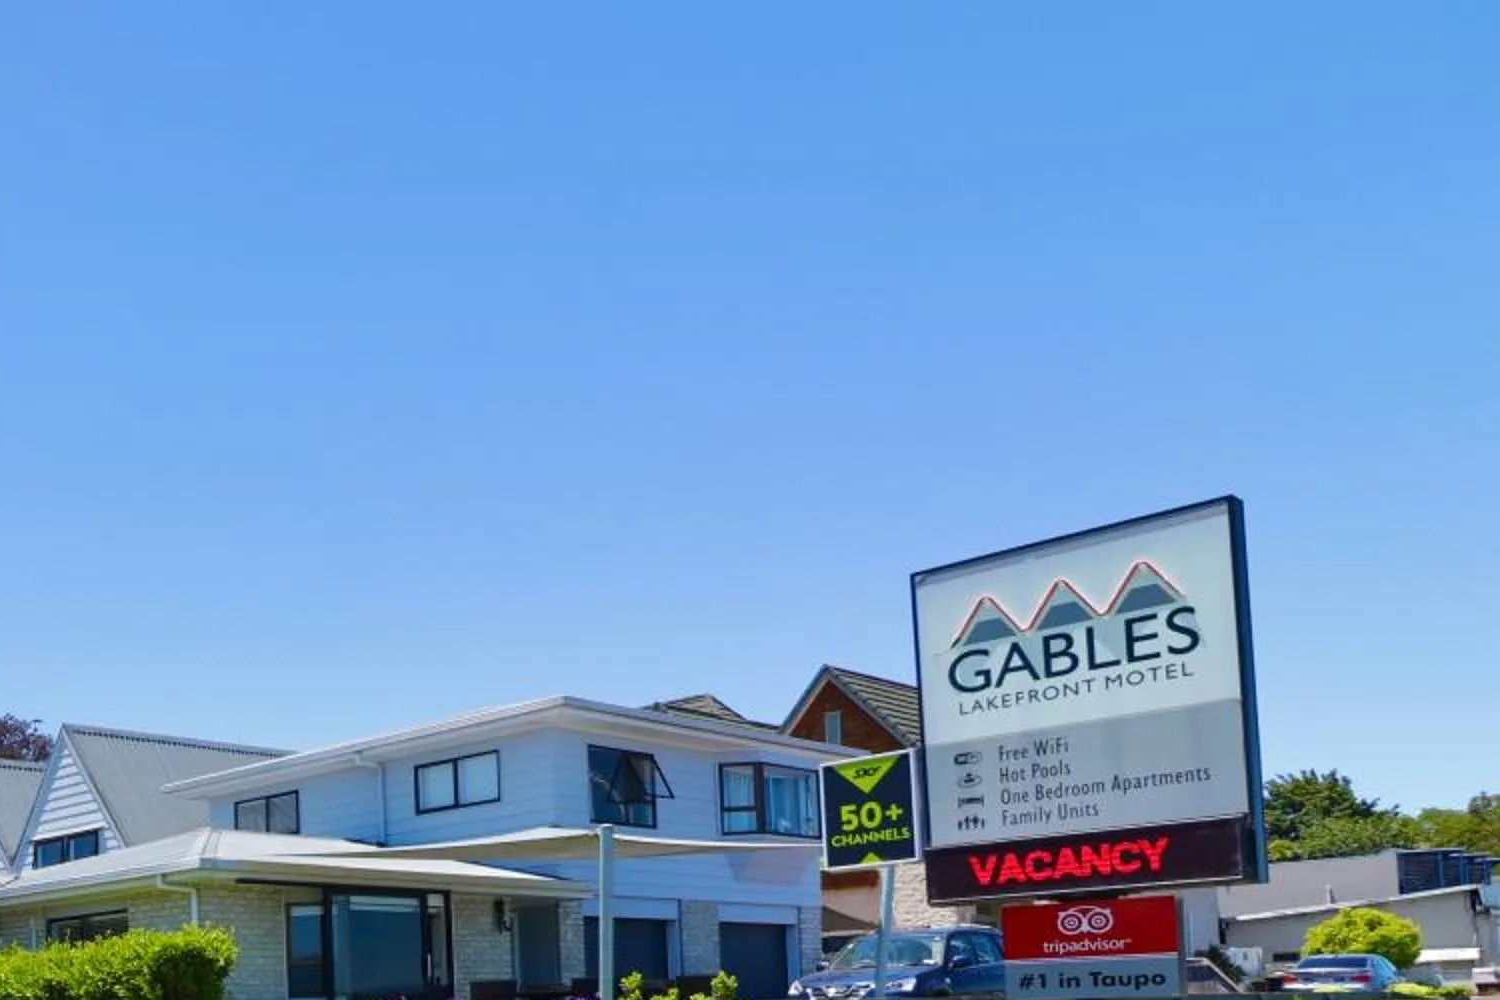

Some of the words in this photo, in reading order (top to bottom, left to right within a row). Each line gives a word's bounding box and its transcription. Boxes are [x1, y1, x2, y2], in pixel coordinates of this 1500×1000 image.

[947, 605, 1201, 694] GABLES
[958, 677, 1097, 716] LAKEFRONT
[1103, 662, 1195, 691] MOTEL
[998, 745, 1030, 762] Free
[1033, 738, 1070, 755] WiFi
[999, 766, 1028, 783] Hot
[1031, 760, 1072, 780] Pools
[1000, 786, 1030, 805] One
[1035, 780, 1105, 802] Bedroom
[1111, 765, 1213, 794] Apartments
[840, 801, 904, 831] 50+
[1001, 808, 1053, 828] Family
[1057, 803, 1100, 820] Units
[831, 827, 911, 848] CHANNELS
[969, 837, 1169, 887] VACANCY
[1042, 938, 1126, 955] tripadvisor
[1019, 972, 1047, 990] #1
[1059, 972, 1081, 989] in
[1089, 970, 1167, 991] Taupo
